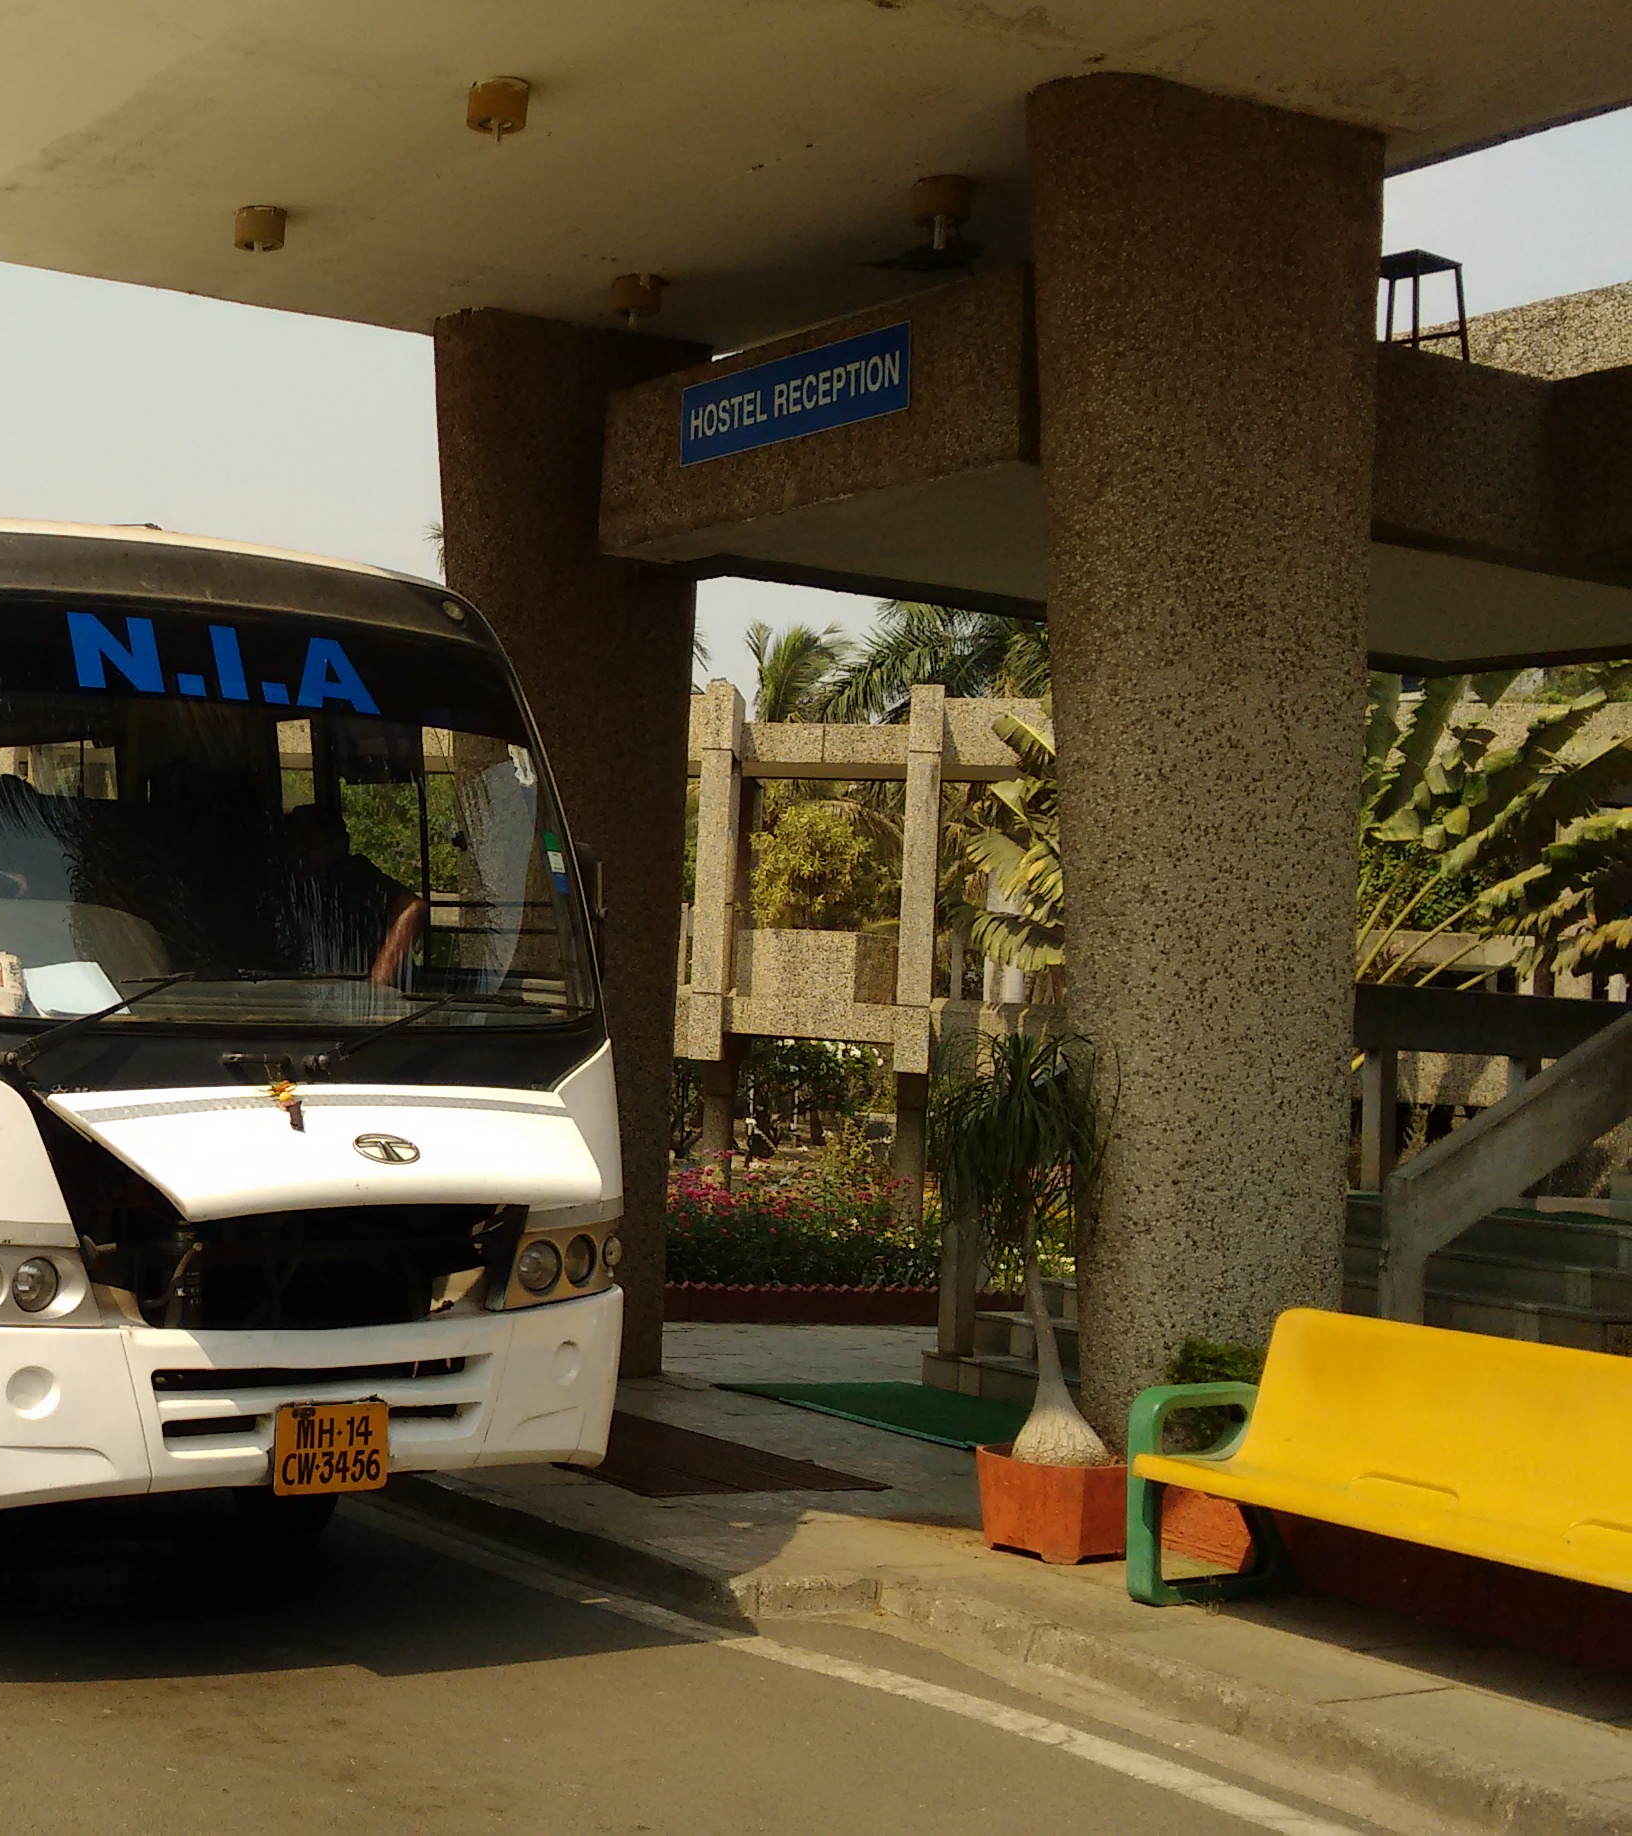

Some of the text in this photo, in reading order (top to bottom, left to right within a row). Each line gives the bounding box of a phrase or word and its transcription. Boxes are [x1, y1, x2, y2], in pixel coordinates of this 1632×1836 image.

[689, 350, 901, 441] HOSTEL RECEPTION
[67, 611, 381, 715] N.I.A
